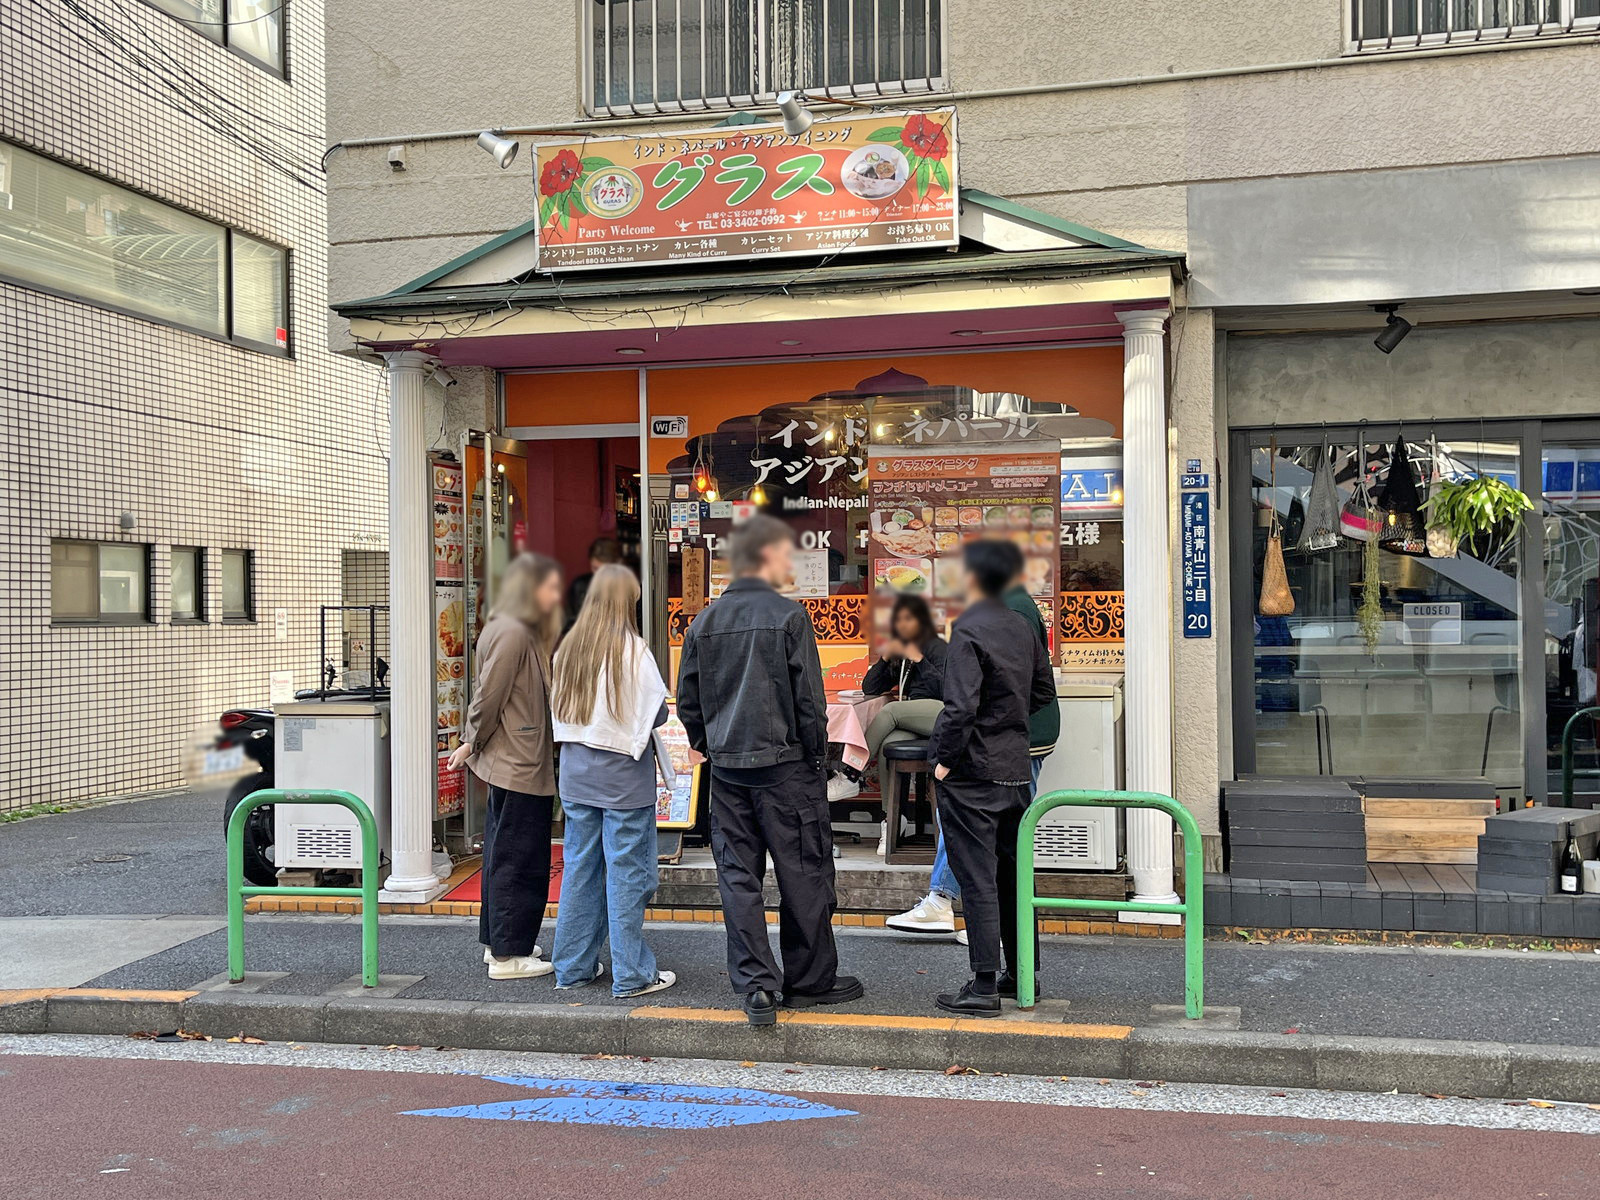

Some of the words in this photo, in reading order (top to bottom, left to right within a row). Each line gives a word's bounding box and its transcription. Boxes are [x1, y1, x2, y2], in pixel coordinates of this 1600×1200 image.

[652, 153, 835, 211] グラス
[600, 187, 625, 200] グラス
[697, 220, 718, 231] TEL:
[720, 214, 786, 229] 03-3402-0992
[886, 223, 932, 235] お持ち帰り
[935, 222, 950, 232] OK
[578, 227, 607, 239] Party
[610, 225, 656, 237] Welcome
[806, 228, 870, 241] アジア料理各種
[674, 239, 718, 250] カレー各種
[741, 233, 793, 246] カレーセット
[543, 249, 585, 260] タンドリー
[586, 247, 607, 257] BBQ
[609, 243, 660, 255] とホットナン
[668, 252, 686, 260] Many
[709, 249, 728, 257] Curry
[892, 457, 978, 472] グラスダイニング
[872, 480, 978, 493] ランチセットメニュー
[1184, 475, 1205, 486] 20-1
[1184, 504, 1193, 558] MINAMI-AOYAMA
[1193, 525, 1207, 602] 南青山二丁目
[1413, 606, 1451, 616] CLOSED
[1187, 614, 1207, 629] 20
